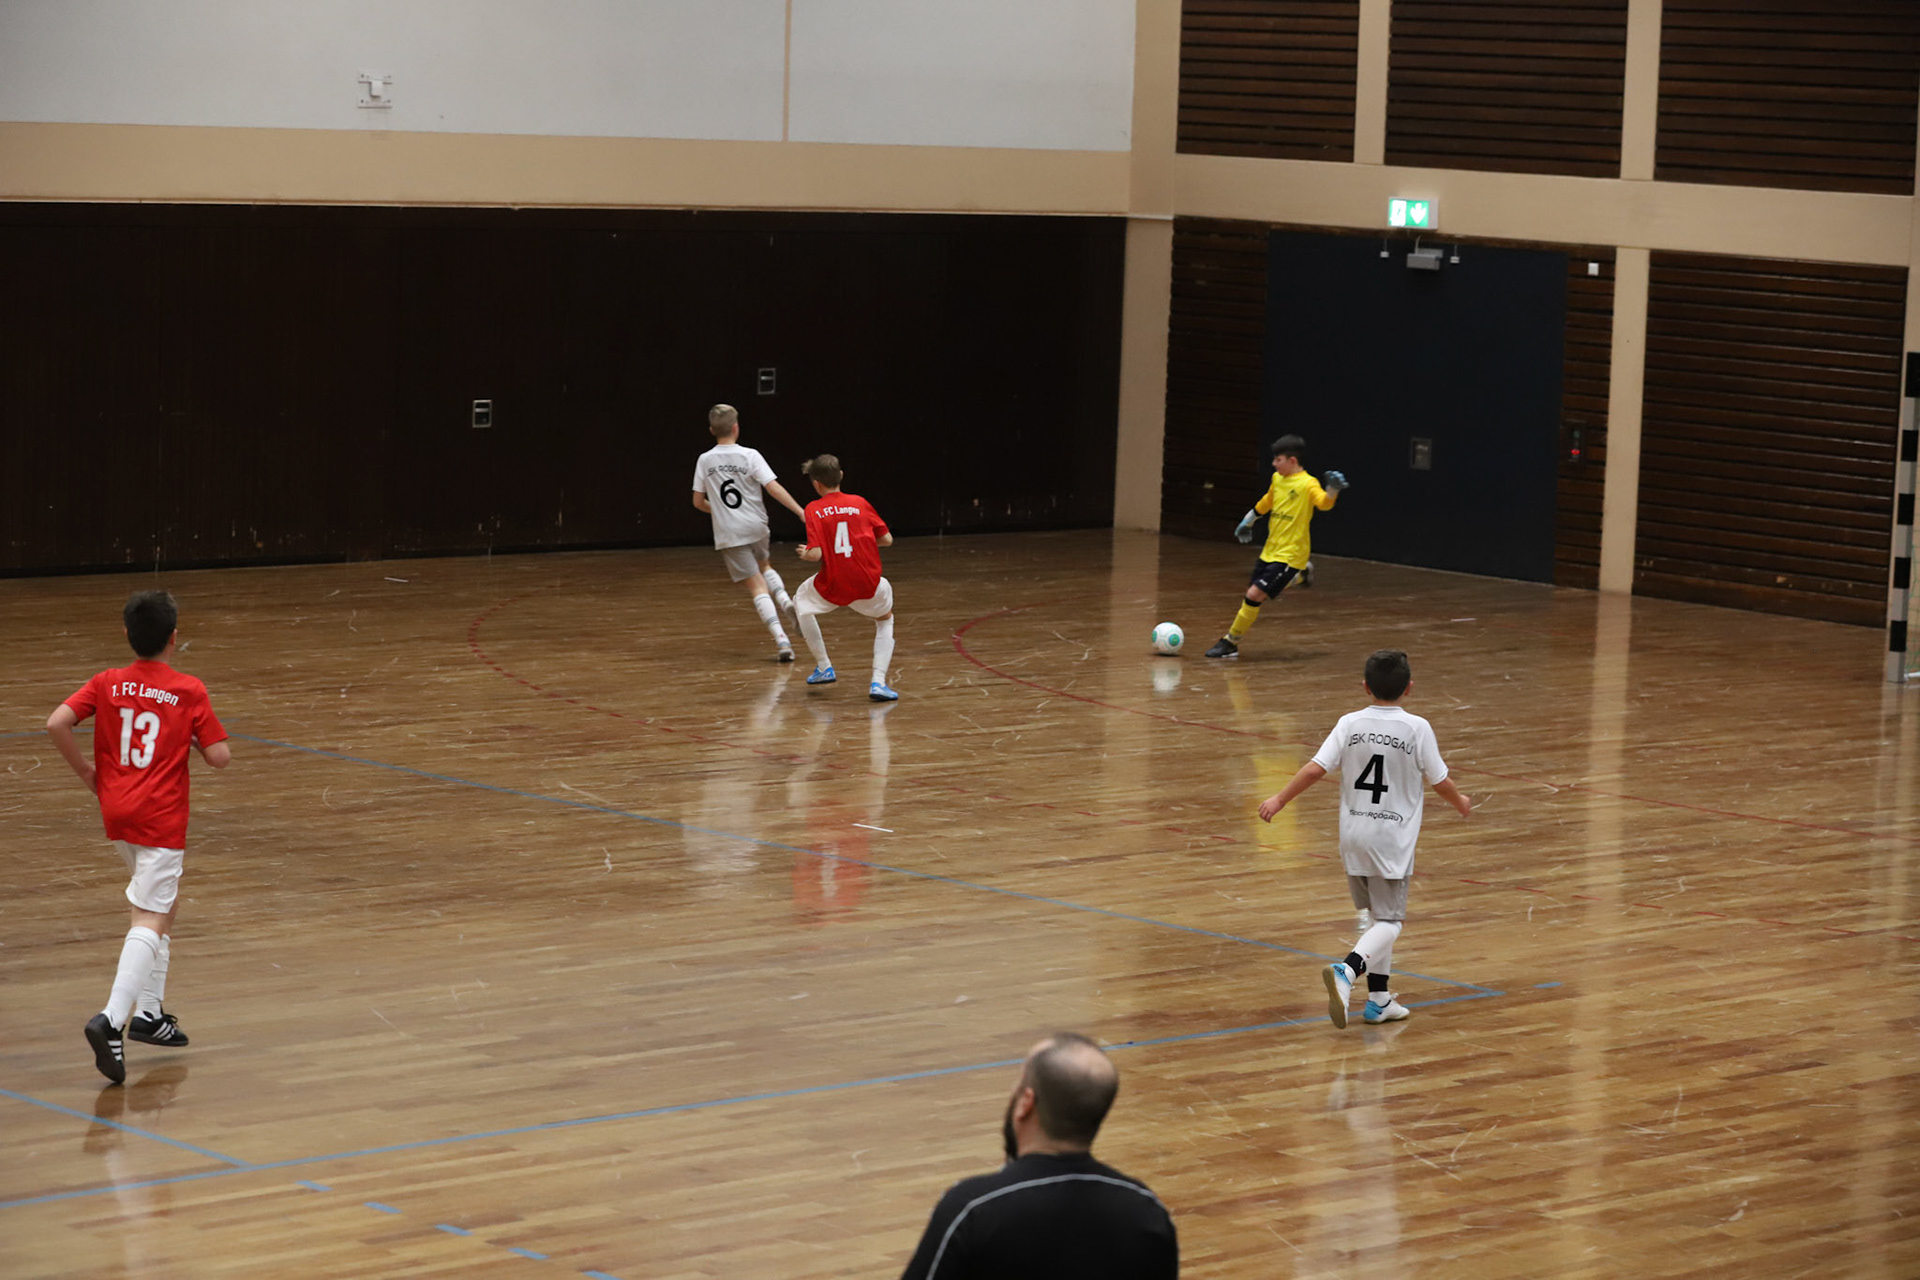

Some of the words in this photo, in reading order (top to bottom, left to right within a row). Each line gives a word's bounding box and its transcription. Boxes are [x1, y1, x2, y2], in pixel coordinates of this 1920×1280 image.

[720, 479, 743, 510] 6
[815, 510, 825, 519] 1.
[823, 506, 835, 516] FC
[835, 505, 860, 516] Langen
[834, 521, 853, 558] 4
[111, 684, 120, 698] 1.
[122, 682, 137, 696] FC
[139, 683, 179, 706] Langen
[119, 707, 161, 769] 13
[1368, 733, 1414, 755] RODGAU
[1354, 754, 1389, 804] 4
